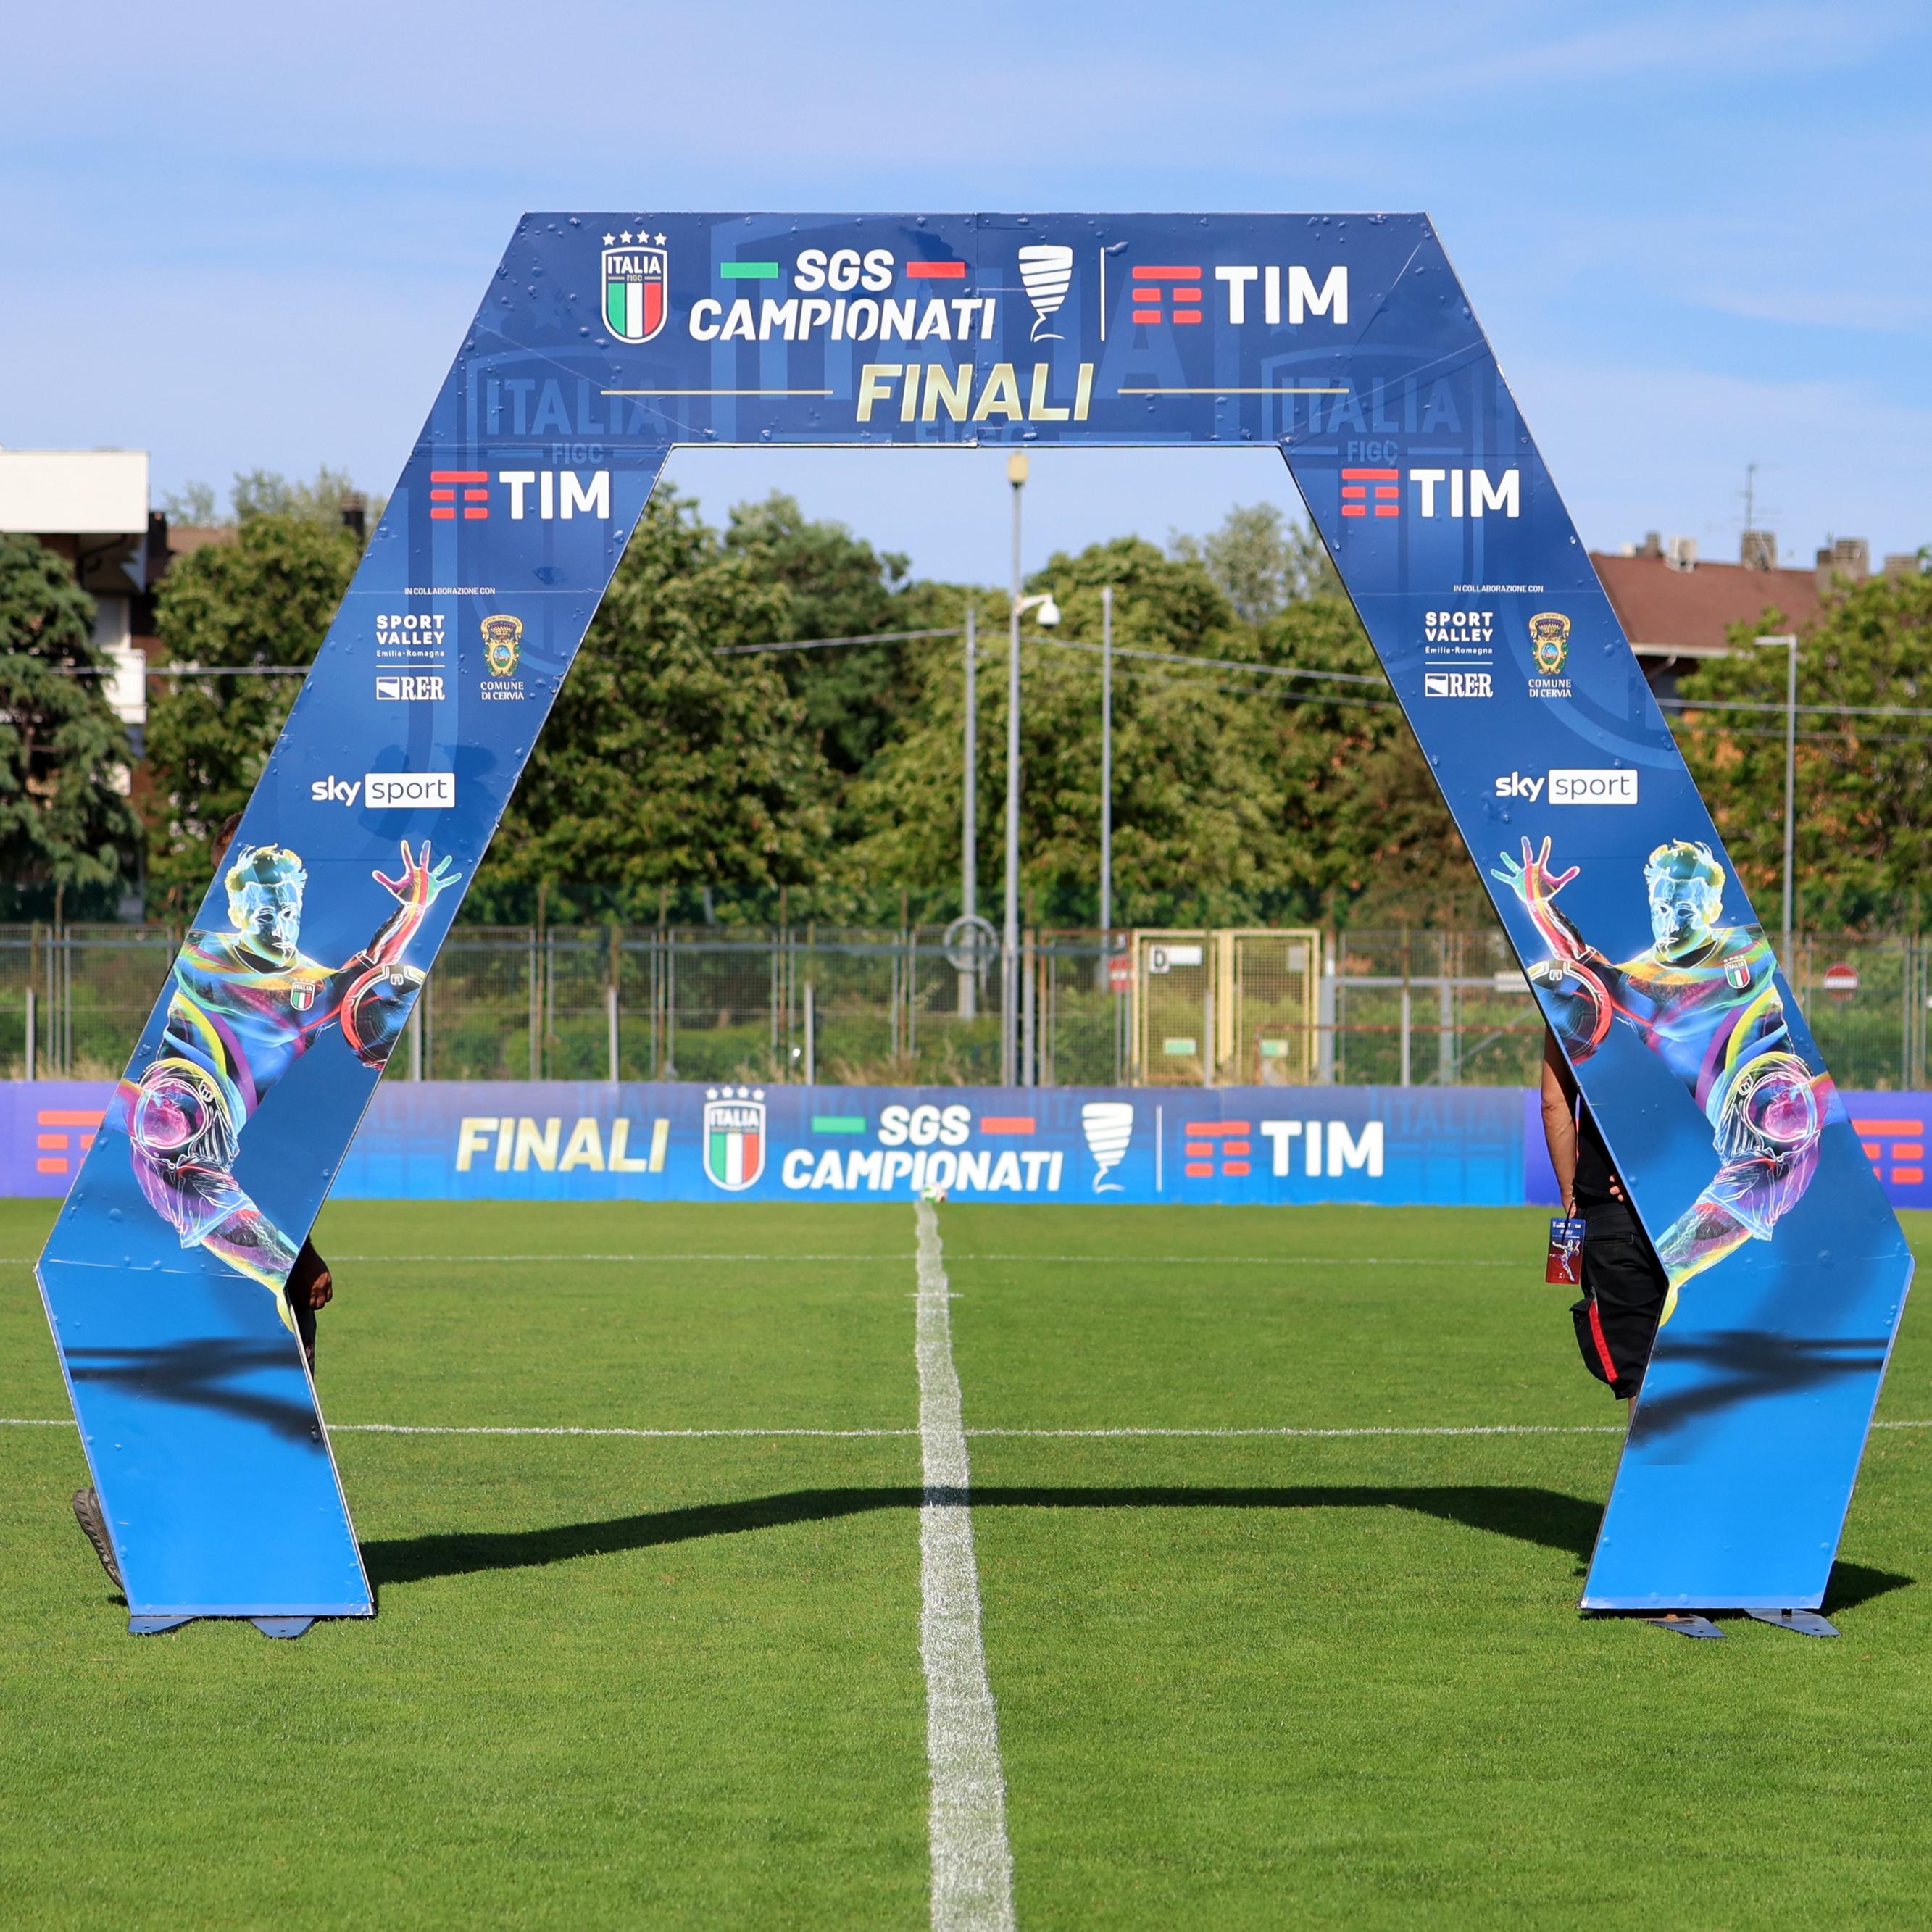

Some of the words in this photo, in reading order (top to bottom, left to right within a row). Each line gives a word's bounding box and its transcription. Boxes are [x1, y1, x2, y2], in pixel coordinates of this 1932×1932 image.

[607, 256, 662, 274] ITALIA
[794, 249, 894, 291] SGS
[1215, 266, 1348, 324] TIM
[689, 299, 996, 341] CAMPIONATI
[487, 379, 668, 435] ITALIA
[857, 363, 1094, 422] FINALI
[1282, 378, 1462, 433] ITALIA
[552, 443, 604, 464] FIGC
[1348, 441, 1398, 462] FIGC
[499, 471, 610, 520] TIM
[1410, 469, 1520, 517] TIM
[376, 615, 444, 629] SPORT
[1425, 612, 1493, 626] SPORT
[1425, 628, 1494, 641] VALLEY
[376, 632, 445, 644] VALLEY
[480, 681, 524, 691] COMUNE
[481, 691, 491, 700] DI
[493, 691, 525, 700] CERVIA
[1528, 679, 1572, 688] COMUNE
[1529, 689, 1538, 698] DI
[1541, 689, 1572, 698] CERVIA
[312, 775, 361, 806] sky
[372, 779, 447, 804] sport
[1496, 771, 1545, 802] sky
[1556, 776, 1631, 800] sport
[1154, 950, 1165, 967] D
[710, 1109, 759, 1127] ITALIA
[878, 1104, 971, 1146] SGS
[456, 1117, 670, 1172] FINALI
[1260, 1120, 1383, 1178] TIM
[782, 1149, 1063, 1191] CAMPIONATI
